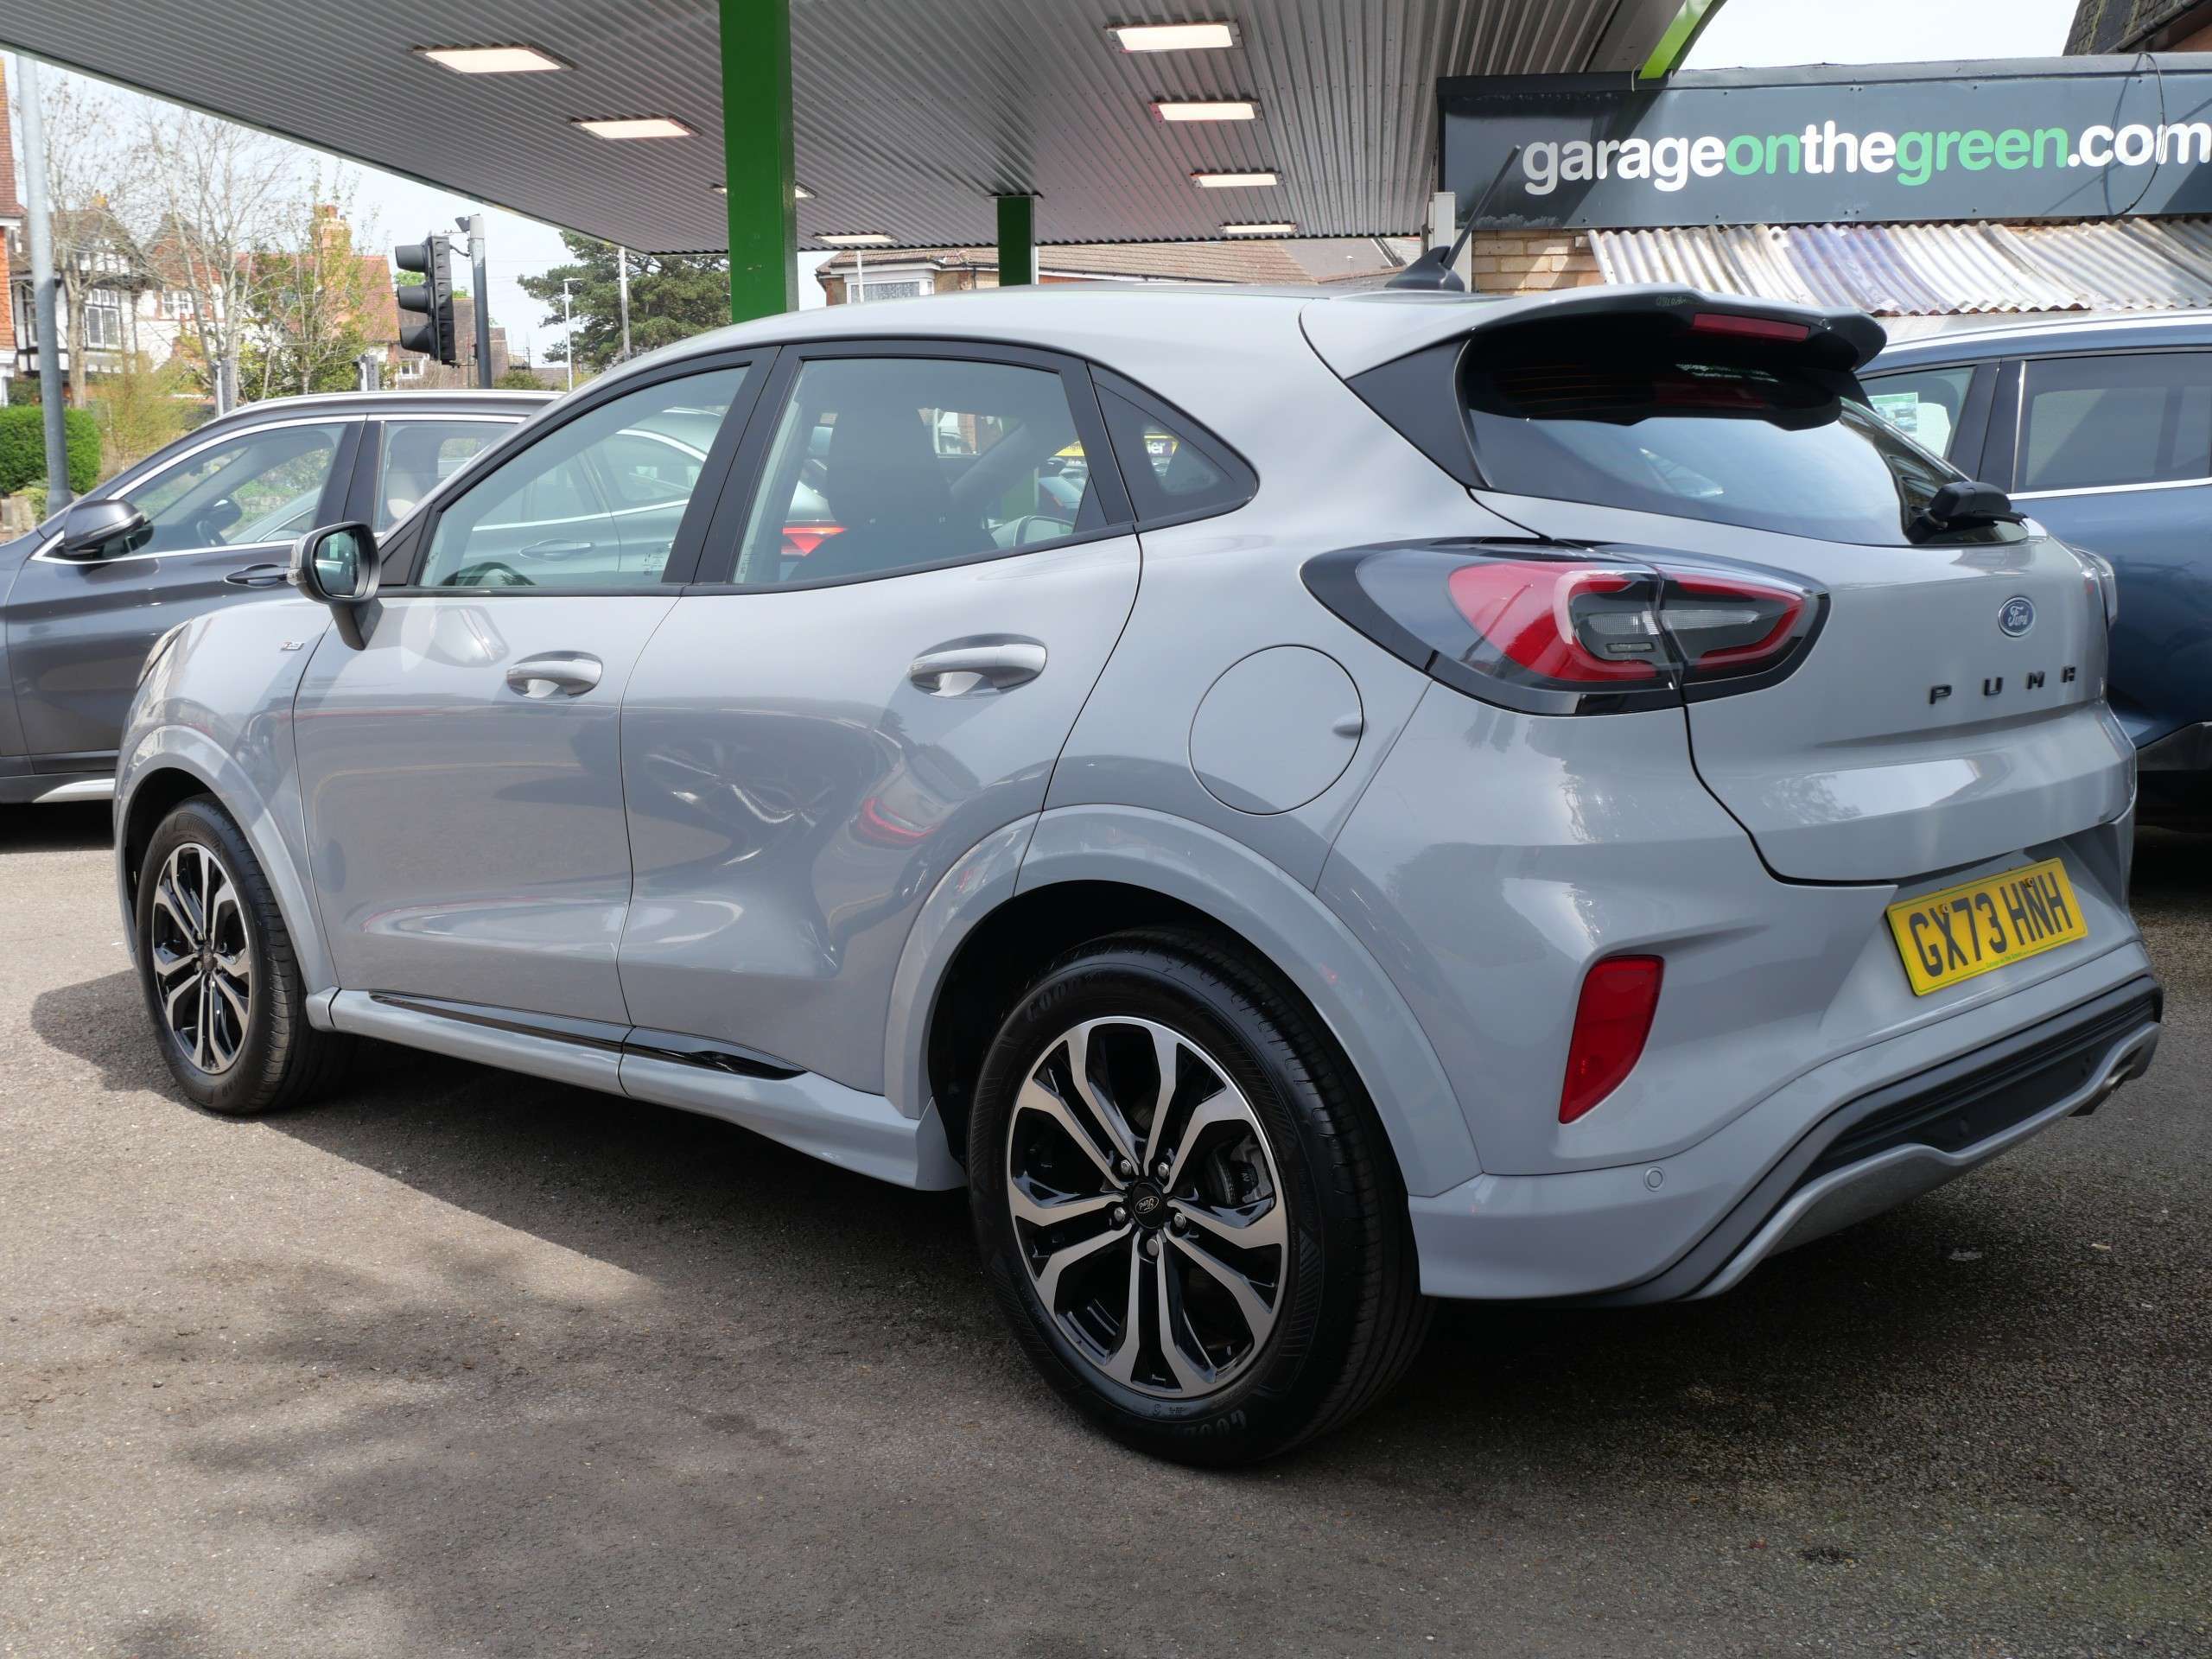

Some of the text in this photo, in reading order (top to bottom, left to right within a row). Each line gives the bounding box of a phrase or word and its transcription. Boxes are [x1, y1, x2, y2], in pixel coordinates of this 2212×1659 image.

[1522, 119, 2211, 195] garageonthegreen.com
[2007, 605, 2030, 627] Ford
[1929, 665, 2076, 705] PUMA
[1909, 871, 2073, 978] GX73 HNH
